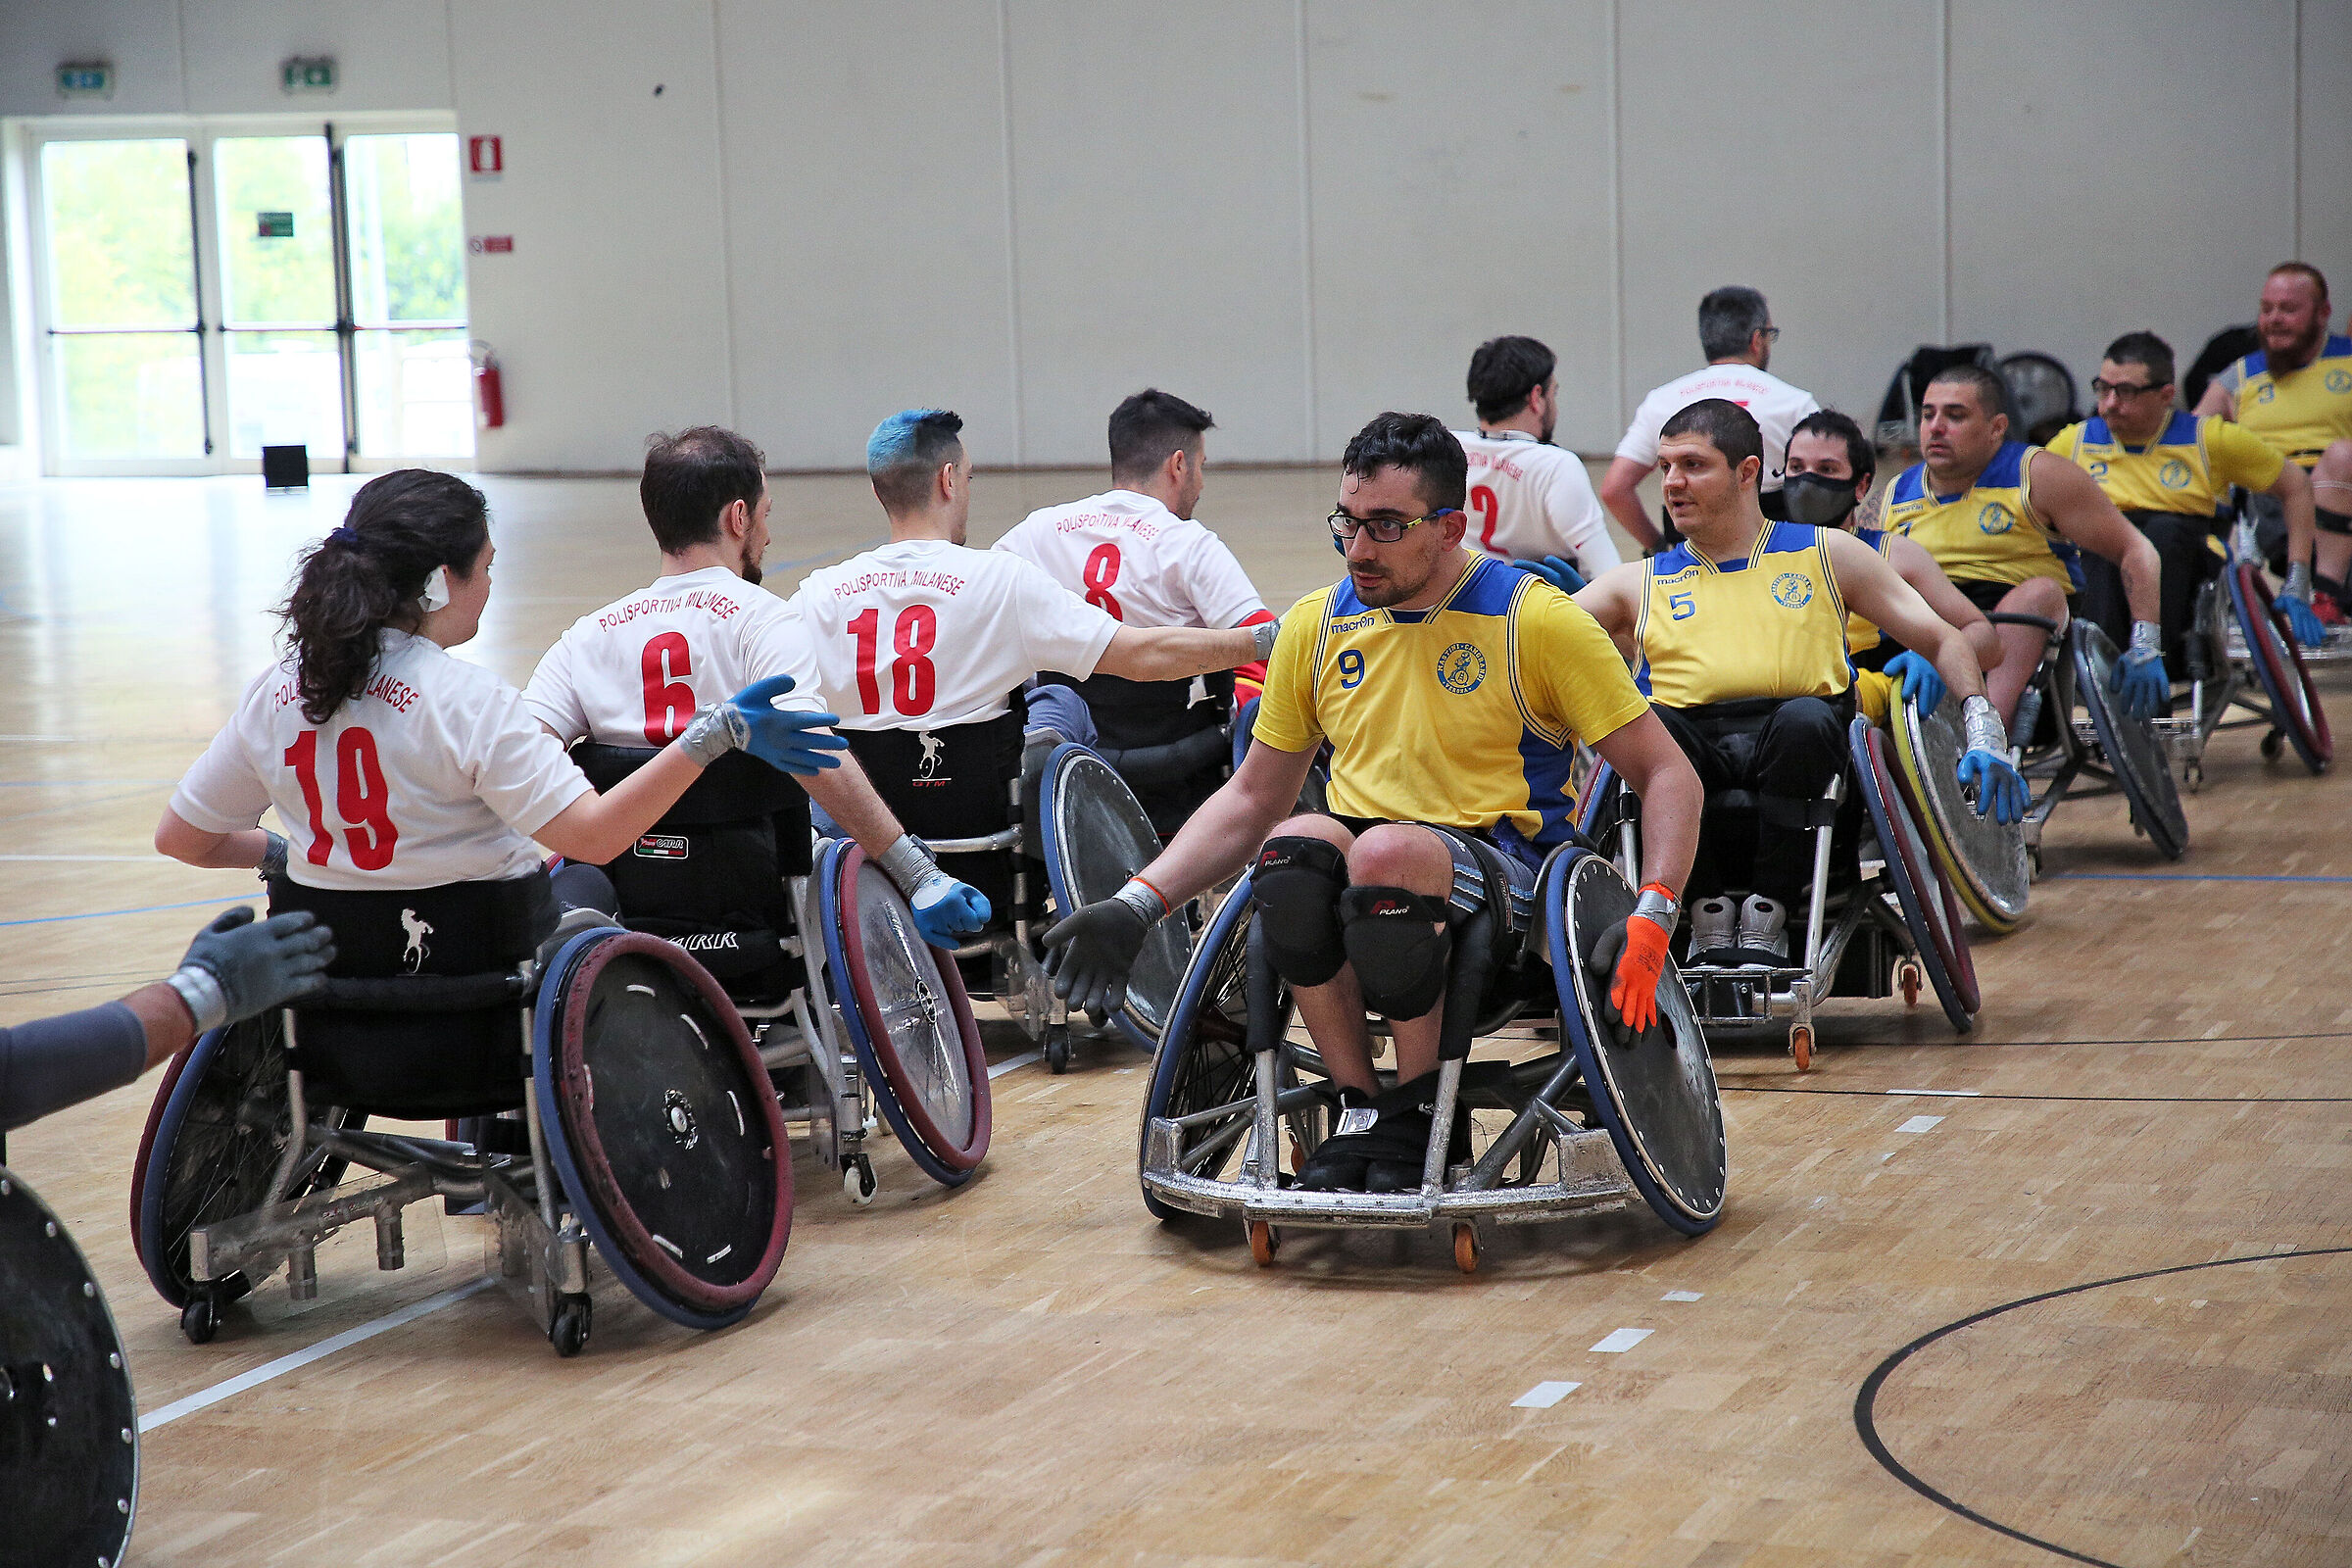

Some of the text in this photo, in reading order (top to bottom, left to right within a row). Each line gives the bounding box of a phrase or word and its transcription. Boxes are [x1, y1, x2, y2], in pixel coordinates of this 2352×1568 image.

[1471, 485, 1509, 556] 2
[834, 569, 965, 601] POLISPORTIVA MILANESE
[1083, 543, 1123, 622] 8
[1656, 568, 1699, 586] macron
[599, 596, 682, 633] POLISPORTIVA
[1331, 615, 1375, 635] macron
[1669, 591, 1696, 621] 5
[847, 604, 938, 716] 18
[1338, 649, 1365, 690] 9
[367, 674, 419, 713] LANESE
[641, 631, 697, 747] 6
[284, 726, 399, 871] 19
[1379, 906, 1409, 915] PLANO
